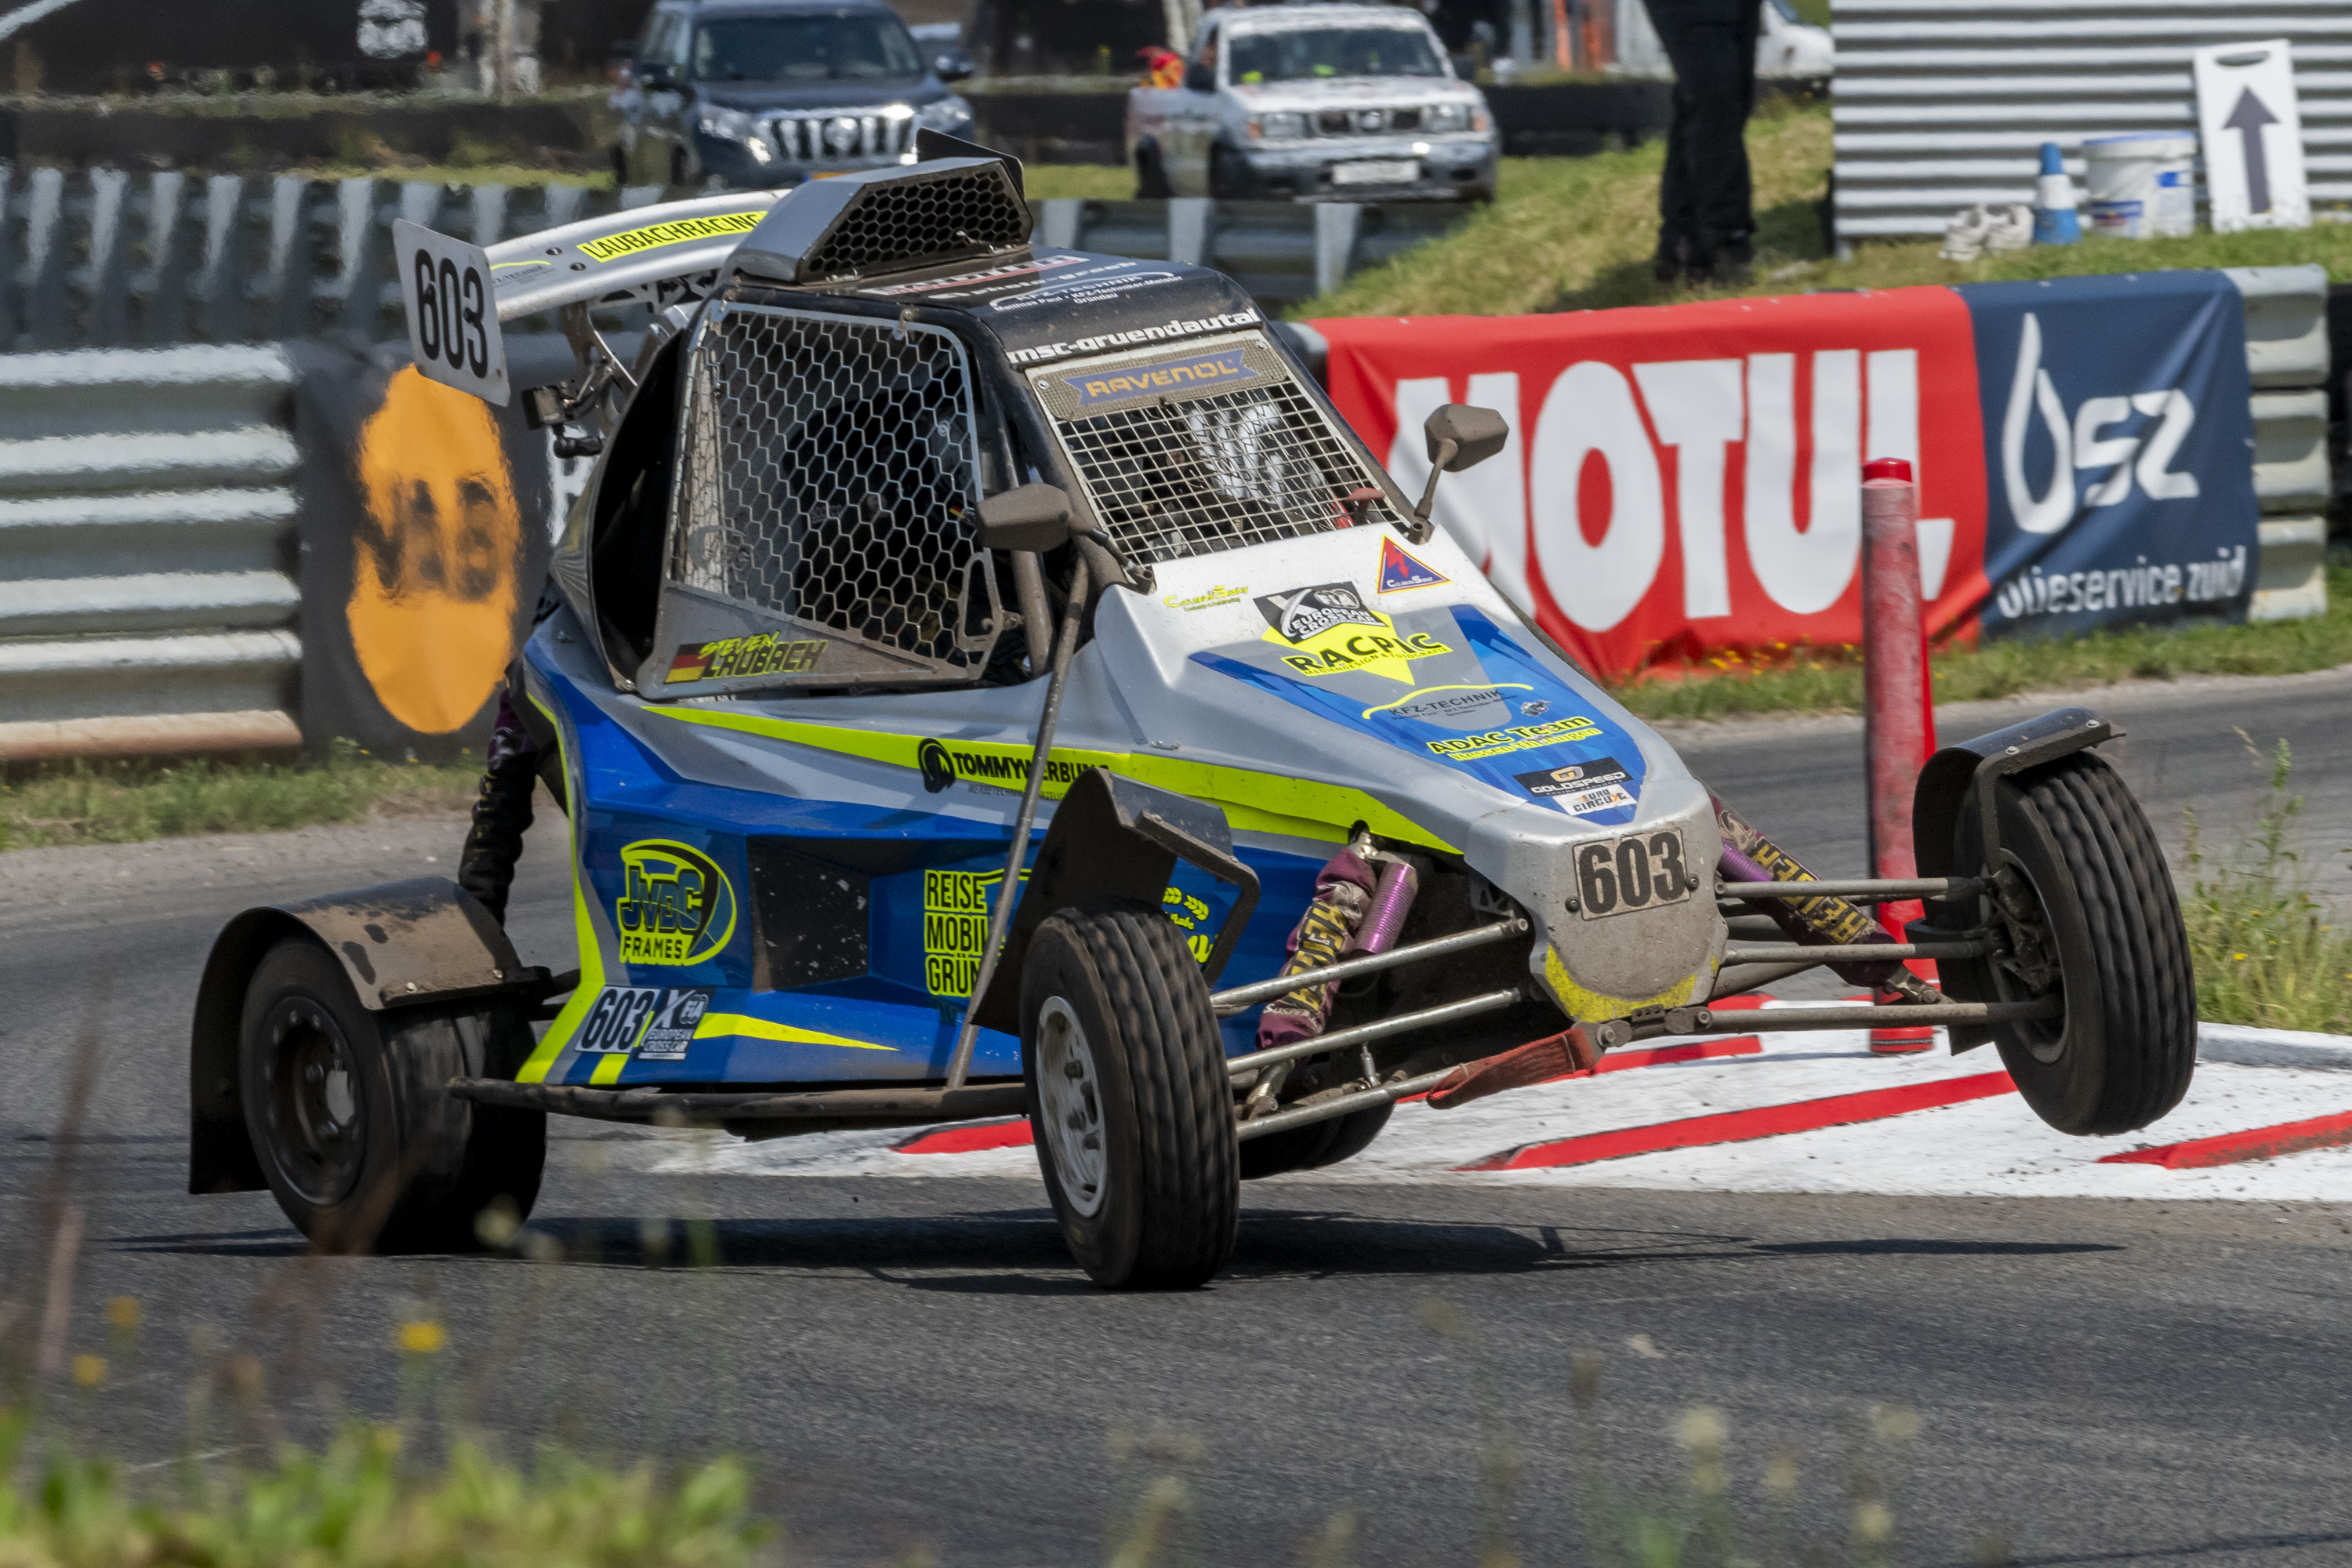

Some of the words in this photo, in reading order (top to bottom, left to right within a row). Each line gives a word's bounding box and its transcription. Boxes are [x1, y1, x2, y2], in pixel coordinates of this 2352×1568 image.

[583, 212, 762, 260] LAUBACHRACING
[416, 249, 488, 379] 603
[1042, 295, 1063, 305] Paul
[1073, 292, 1120, 305] Gründau
[1007, 308, 1261, 365] msc-gruendautal
[1085, 359, 1239, 397] RAVENOL
[1388, 348, 1955, 632] MOTUL
[1291, 608, 1371, 630] EUROPEAN
[1288, 633, 1443, 672] RACPIC
[1305, 654, 1380, 676] MEDIENDESIGN
[1389, 647, 1450, 661] FOTOGRAFIE
[1389, 688, 1505, 717] KFZ-TECHNIK
[1429, 731, 1512, 753] ADAC
[1512, 716, 1592, 739] Team
[1531, 771, 1626, 793] GOLDSPEED
[1583, 789, 1610, 802] EURO
[927, 873, 985, 909] REISE
[1578, 832, 1686, 914] 603
[622, 937, 683, 960] FRAMES
[928, 953, 981, 994] GRÜN
[580, 988, 655, 1051] 603
[680, 1000, 706, 1018] FIA
